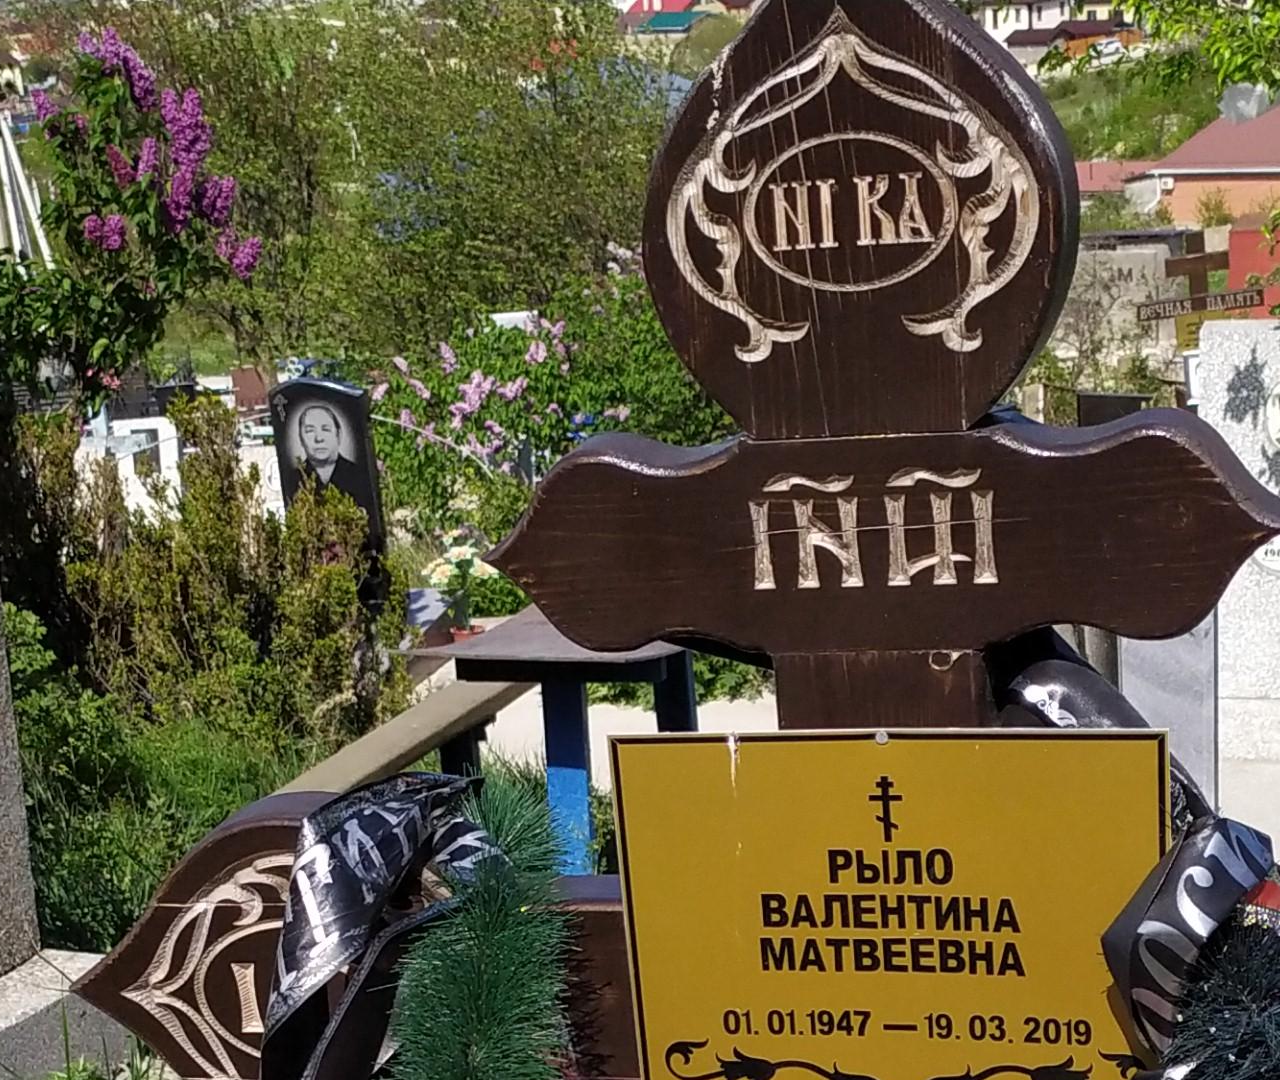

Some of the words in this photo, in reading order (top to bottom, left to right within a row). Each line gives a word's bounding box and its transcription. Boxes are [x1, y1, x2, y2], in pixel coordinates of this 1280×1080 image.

[827, 848, 954, 885] РЫЛО
[761, 893, 1021, 934] ВАЛЕНТИНА
[760, 937, 1026, 977] МАТВЕЕВНА
